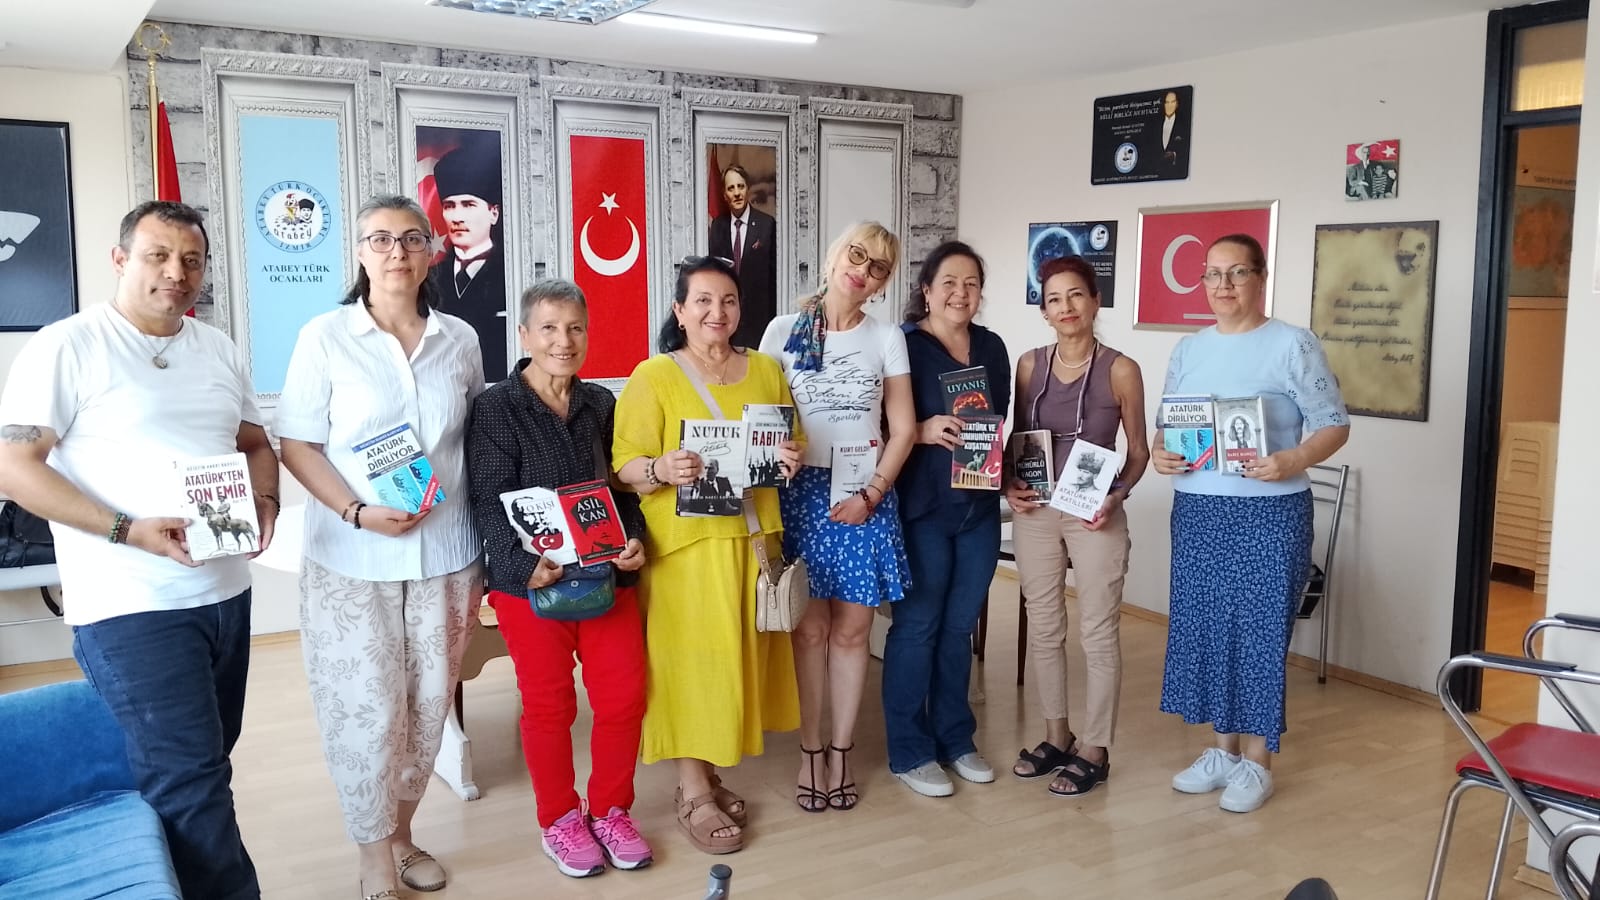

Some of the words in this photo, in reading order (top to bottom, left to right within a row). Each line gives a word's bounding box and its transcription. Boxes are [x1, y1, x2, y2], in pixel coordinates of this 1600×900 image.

[261, 264, 300, 273] ATABEY
[303, 263, 330, 273] TÜRK
[269, 275, 323, 283] OCAKLARI
[947, 379, 986, 393] UYANIŞ
[1170, 403, 1205, 413] ATATÜRK
[1167, 413, 1208, 423] DİRİLİYOR
[692, 426, 741, 439] NUTUK
[988, 423, 997, 432] VE
[366, 435, 408, 460] ATATÜRK
[964, 442, 992, 452] KUŞATMA
[367, 444, 416, 472] DİRİLİYOR
[185, 469, 244, 487] ATATÜRK'TEN
[186, 487, 213, 504] SON
[215, 481, 248, 500] EMİR
[577, 497, 603, 513] ASİL
[578, 508, 608, 524] KAN
